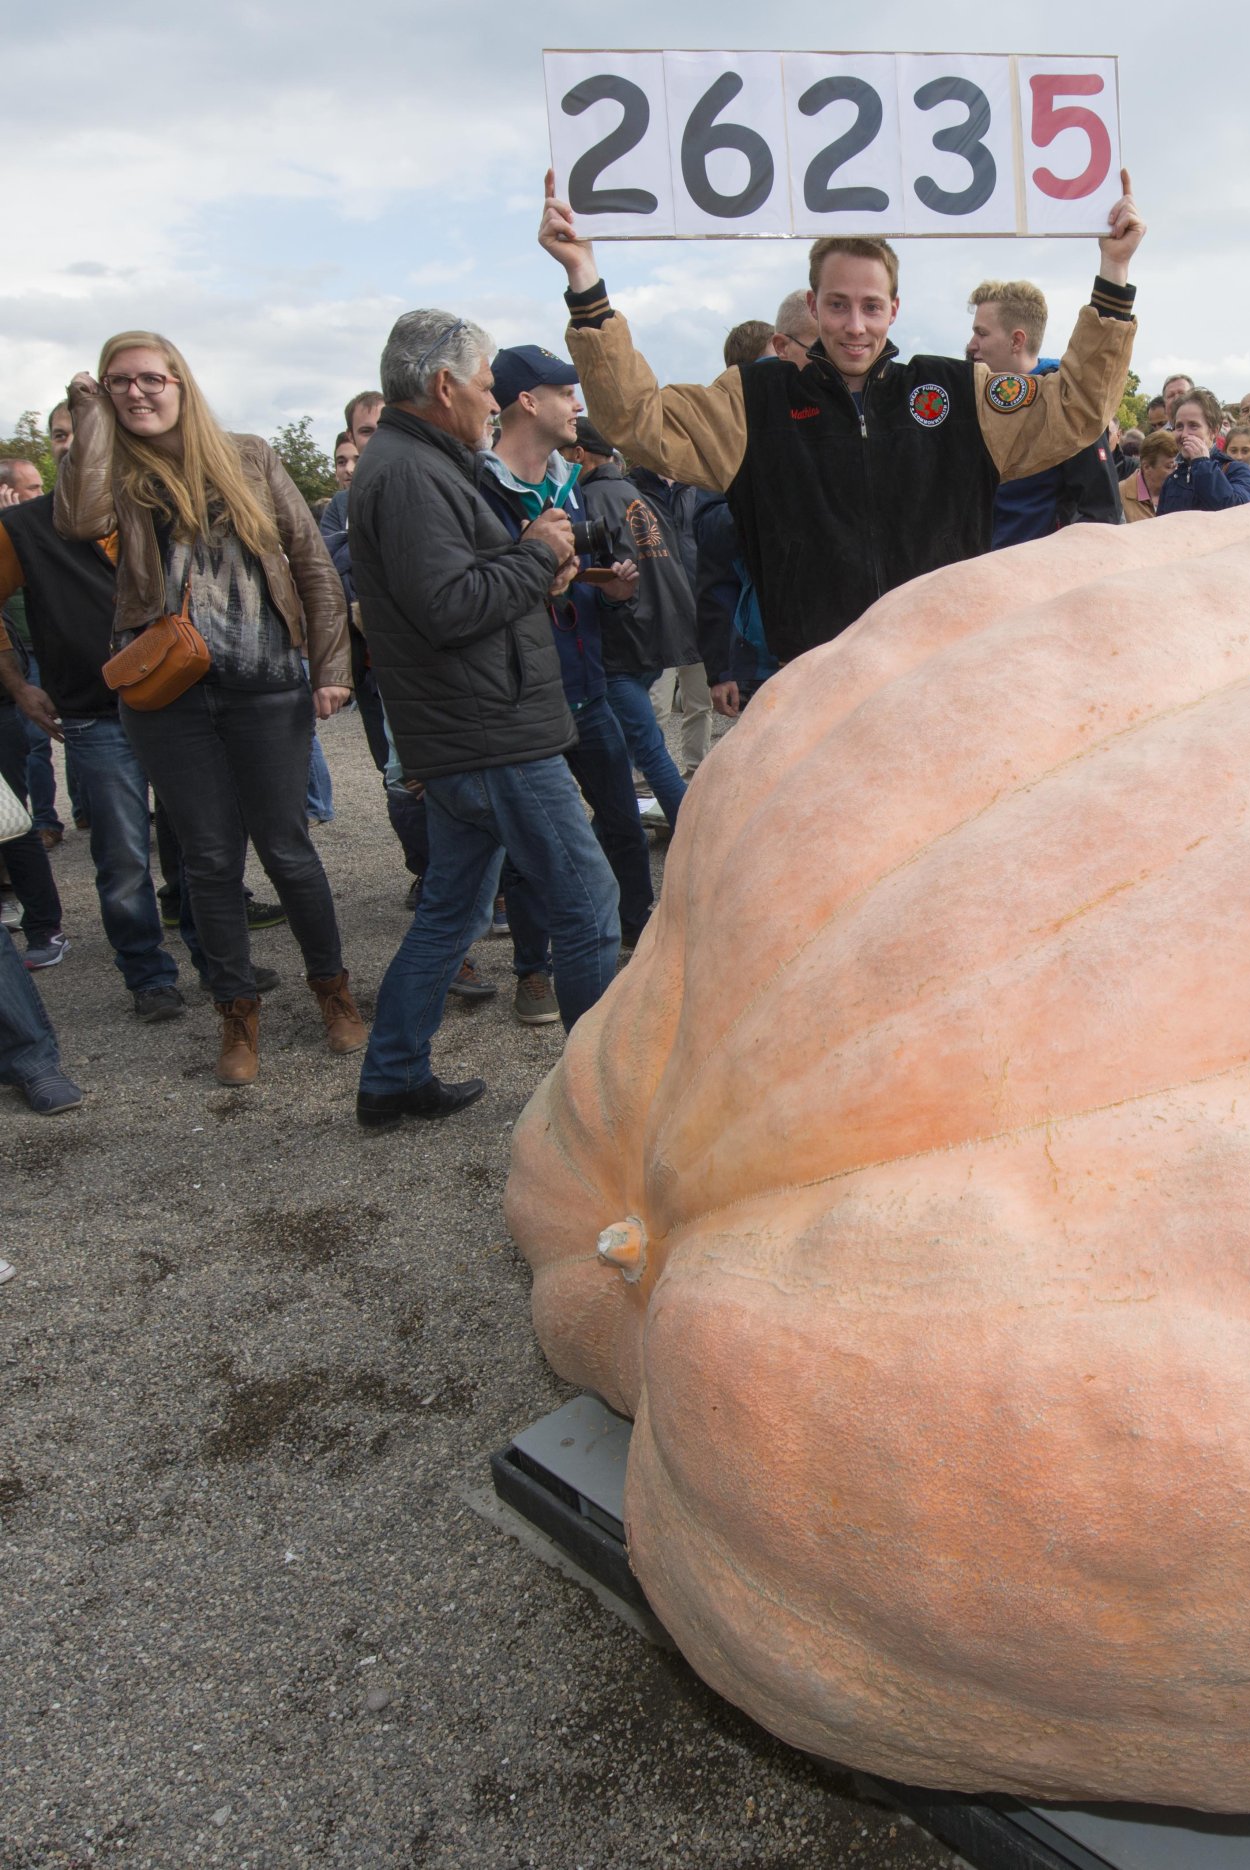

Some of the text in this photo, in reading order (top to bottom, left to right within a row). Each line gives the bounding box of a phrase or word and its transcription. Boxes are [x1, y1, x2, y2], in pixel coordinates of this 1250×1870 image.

[909, 385, 945, 406] GREAT PUMPKIN
[913, 405, 948, 425] COMMONWEALTH
